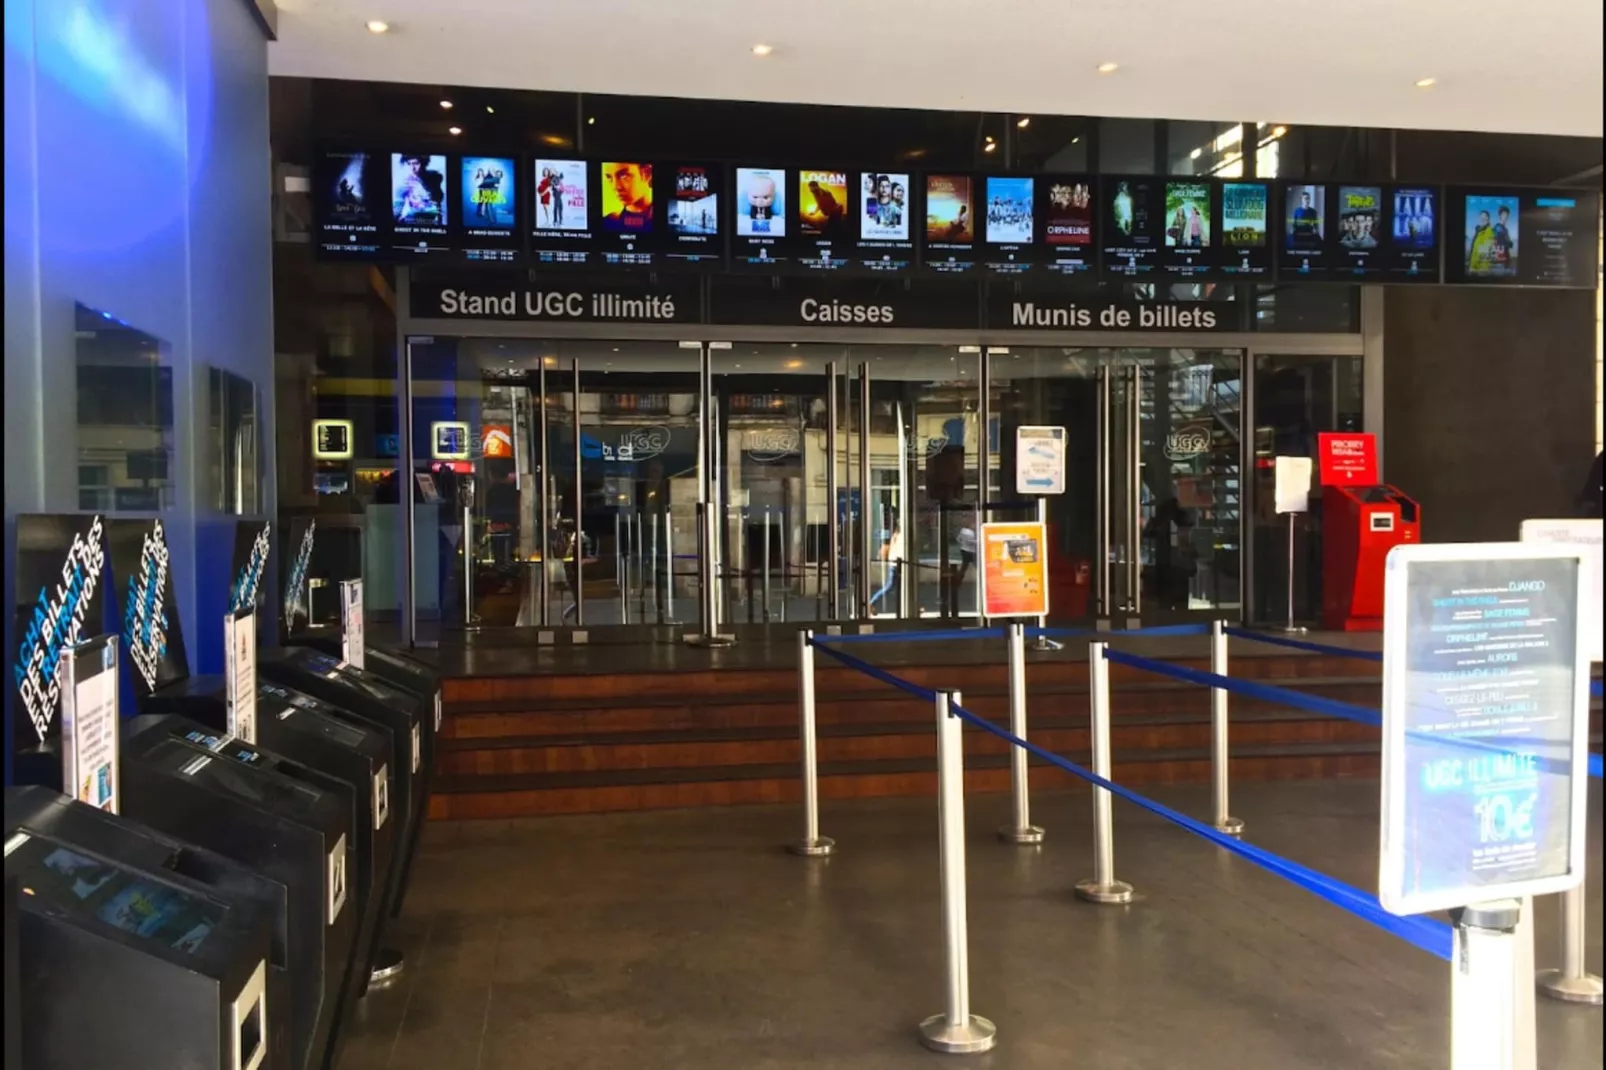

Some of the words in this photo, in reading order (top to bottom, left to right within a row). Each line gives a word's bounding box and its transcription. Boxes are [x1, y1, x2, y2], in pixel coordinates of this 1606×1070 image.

[801, 173, 847, 185] LOGAN
[1047, 226, 1091, 236] ORPHELINE
[1230, 231, 1260, 241] LION
[440, 288, 516, 315] Stand
[525, 290, 584, 317] UGC
[592, 293, 675, 319] illimité
[800, 297, 894, 323] Caisses
[1012, 302, 1092, 326] Munis
[1099, 304, 1131, 327] de
[1139, 304, 1217, 328] billets
[620, 432, 662, 450] UGC
[751, 433, 793, 451] UGC
[42, 562, 84, 684] RETRAIT
[82, 514, 103, 570] DES
[1509, 580, 1545, 592] DJANGO
[20, 641, 46, 708] DES
[42, 532, 85, 647] BILLETS
[14, 585, 50, 690] ACHAT
[1423, 758, 1463, 788] UGC
[1473, 792, 1538, 843] 10€
